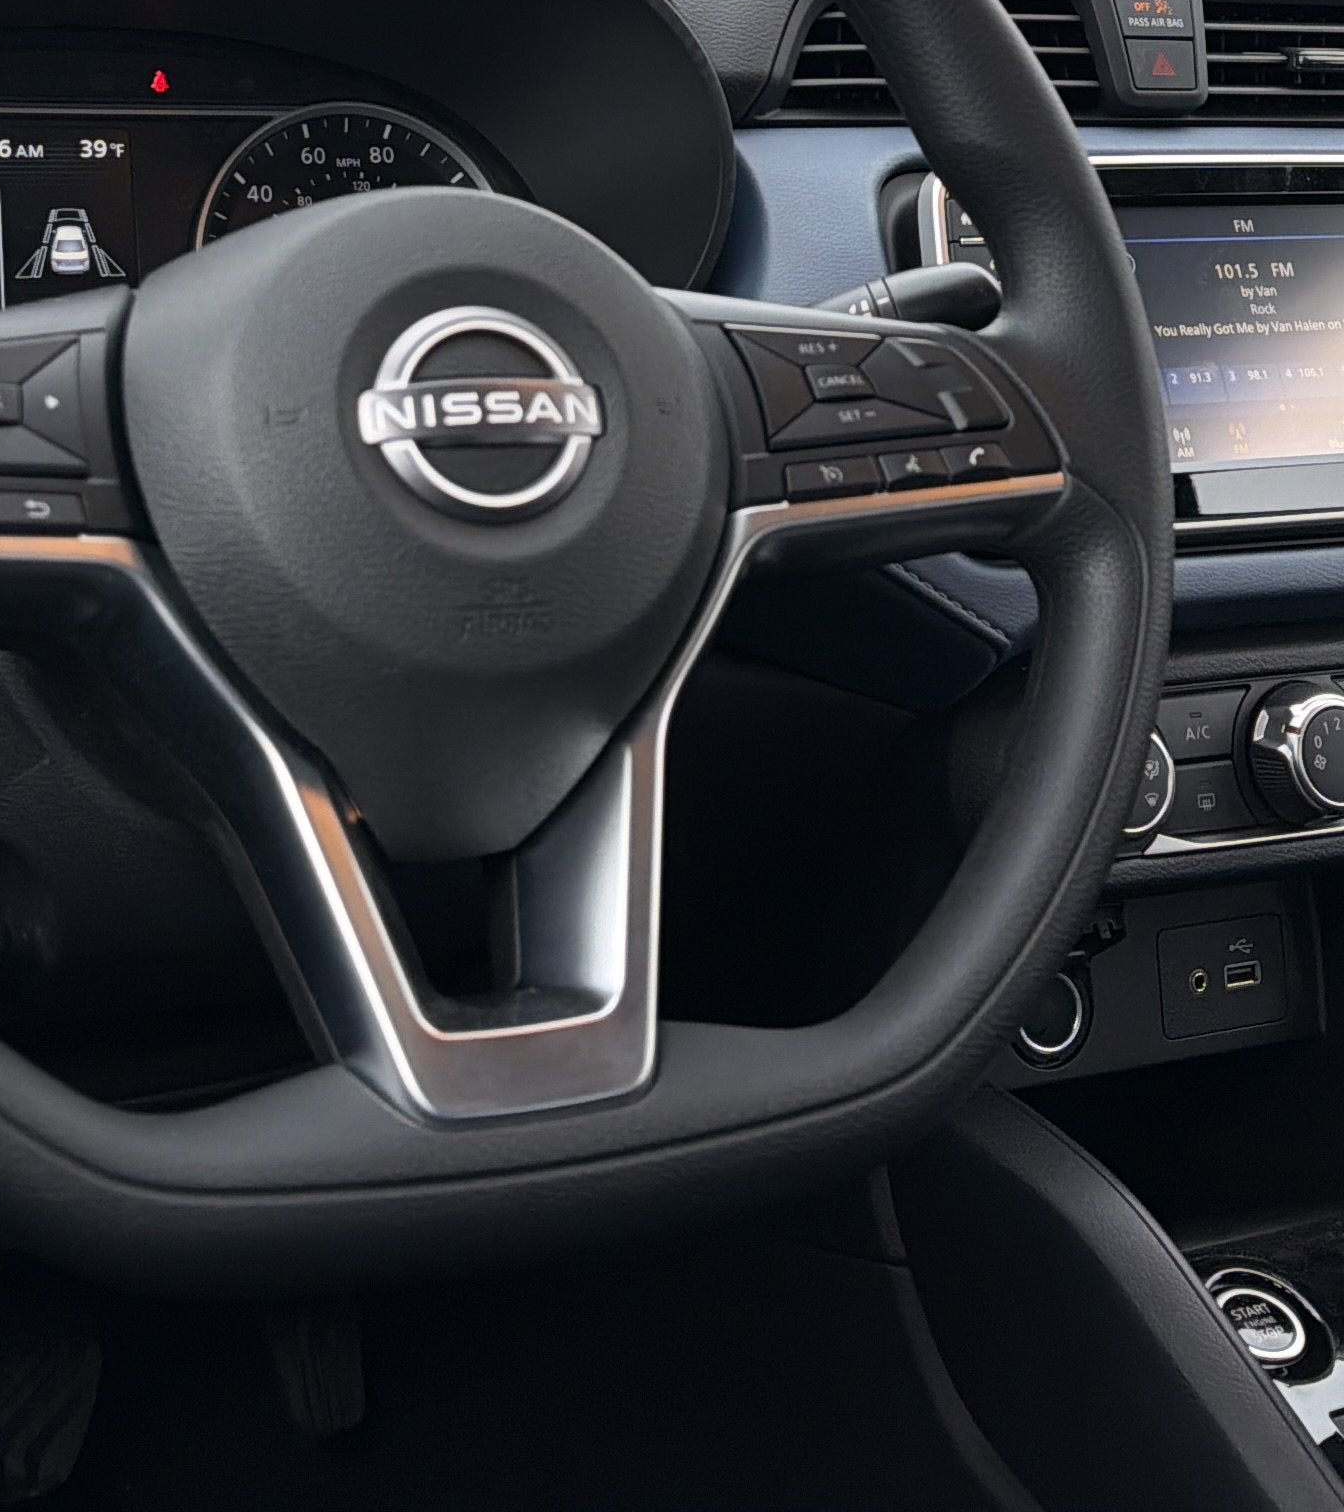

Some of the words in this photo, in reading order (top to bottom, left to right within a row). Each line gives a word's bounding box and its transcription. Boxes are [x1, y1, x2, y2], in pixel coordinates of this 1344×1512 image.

[1133, 1, 1151, 12] OFF
[1128, 17, 1149, 27] PASS
[1151, 17, 1165, 27] AIR
[1167, 18, 1184, 28] BAG
[15, 145, 44, 158] AM
[301, 146, 326, 165] 60
[369, 146, 394, 164] 80
[336, 158, 360, 168] MPH
[353, 181, 370, 191] 120
[246, 185, 273, 203] 40
[297, 196, 312, 207] 80
[1233, 219, 1254, 233] FM
[1215, 263, 1259, 280] 101.5
[1271, 262, 1295, 278] FM
[1240, 286, 1254, 299] by
[1255, 285, 1277, 297] Van
[1250, 303, 1276, 316] Rock
[1154, 324, 1177, 338] You
[1179, 322, 1211, 338] Really
[1213, 321, 1234, 335] Got
[1236, 321, 1254, 334] Me
[1256, 321, 1269, 336] by
[1270, 320, 1292, 333] Van
[1294, 319, 1325, 332] Halen
[1327, 321, 1341, 331] on
[798, 342, 825, 355] RES
[1170, 374, 1178, 385] 2
[1189, 372, 1212, 383] 91.3
[1228, 371, 1236, 382] 3
[1247, 369, 1269, 381] 98.1
[1285, 368, 1292, 378] 4
[817, 374, 865, 387] CANCEL
[376, 390, 598, 430] NISSAN
[838, 410, 862, 423] SET
[1177, 447, 1194, 459] AM
[1234, 444, 1250, 455] FM
[1323, 721, 1329, 734] 1
[1334, 717, 1341, 731] 2
[1185, 723, 1211, 741] A/C
[1314, 735, 1322, 749] 0
[1231, 1303, 1271, 1321] START
[1255, 1325, 1285, 1343] STOP
